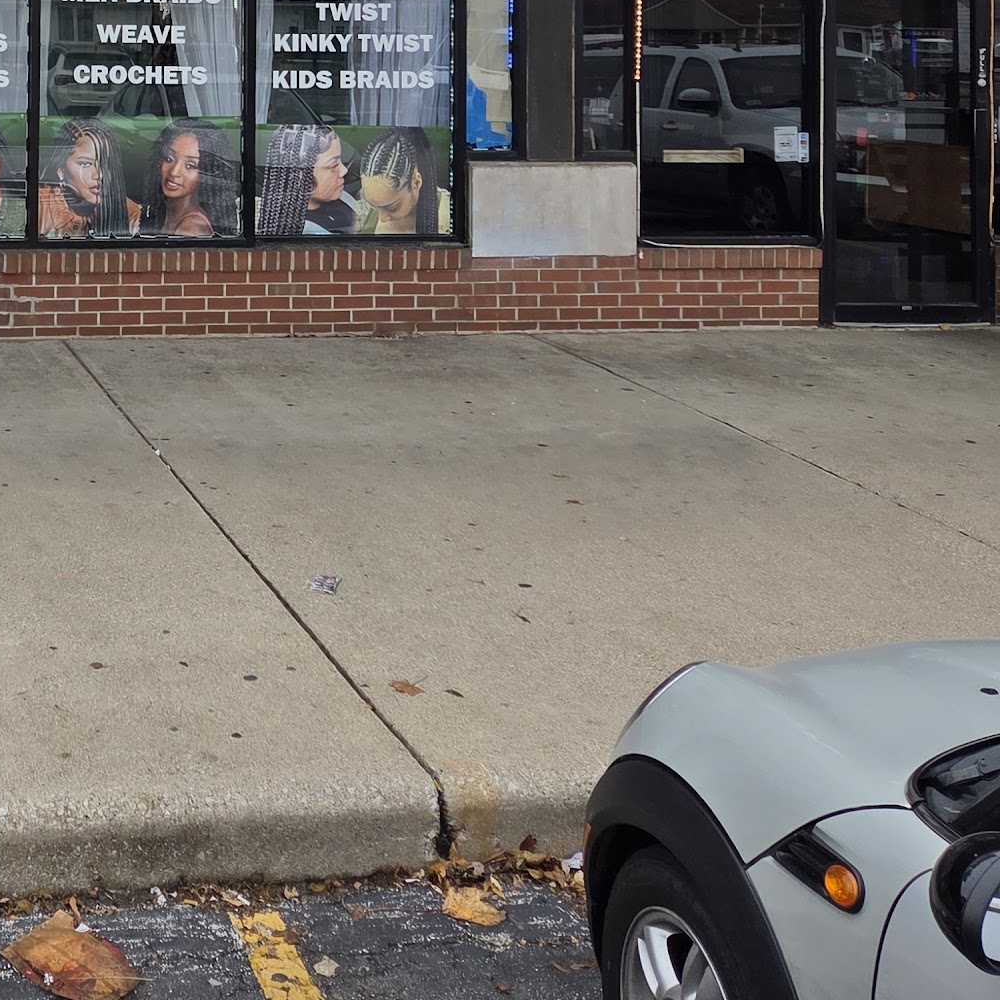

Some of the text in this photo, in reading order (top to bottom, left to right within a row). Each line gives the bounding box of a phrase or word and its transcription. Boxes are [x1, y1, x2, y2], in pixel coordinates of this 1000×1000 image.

[315, 2, 392, 22] TWIST
[96, 24, 187, 44] WEAVE
[274, 33, 434, 52] KINKY TWIST
[73, 65, 208, 85] CROCHETS
[272, 70, 435, 89] KIDS BRAIDS
